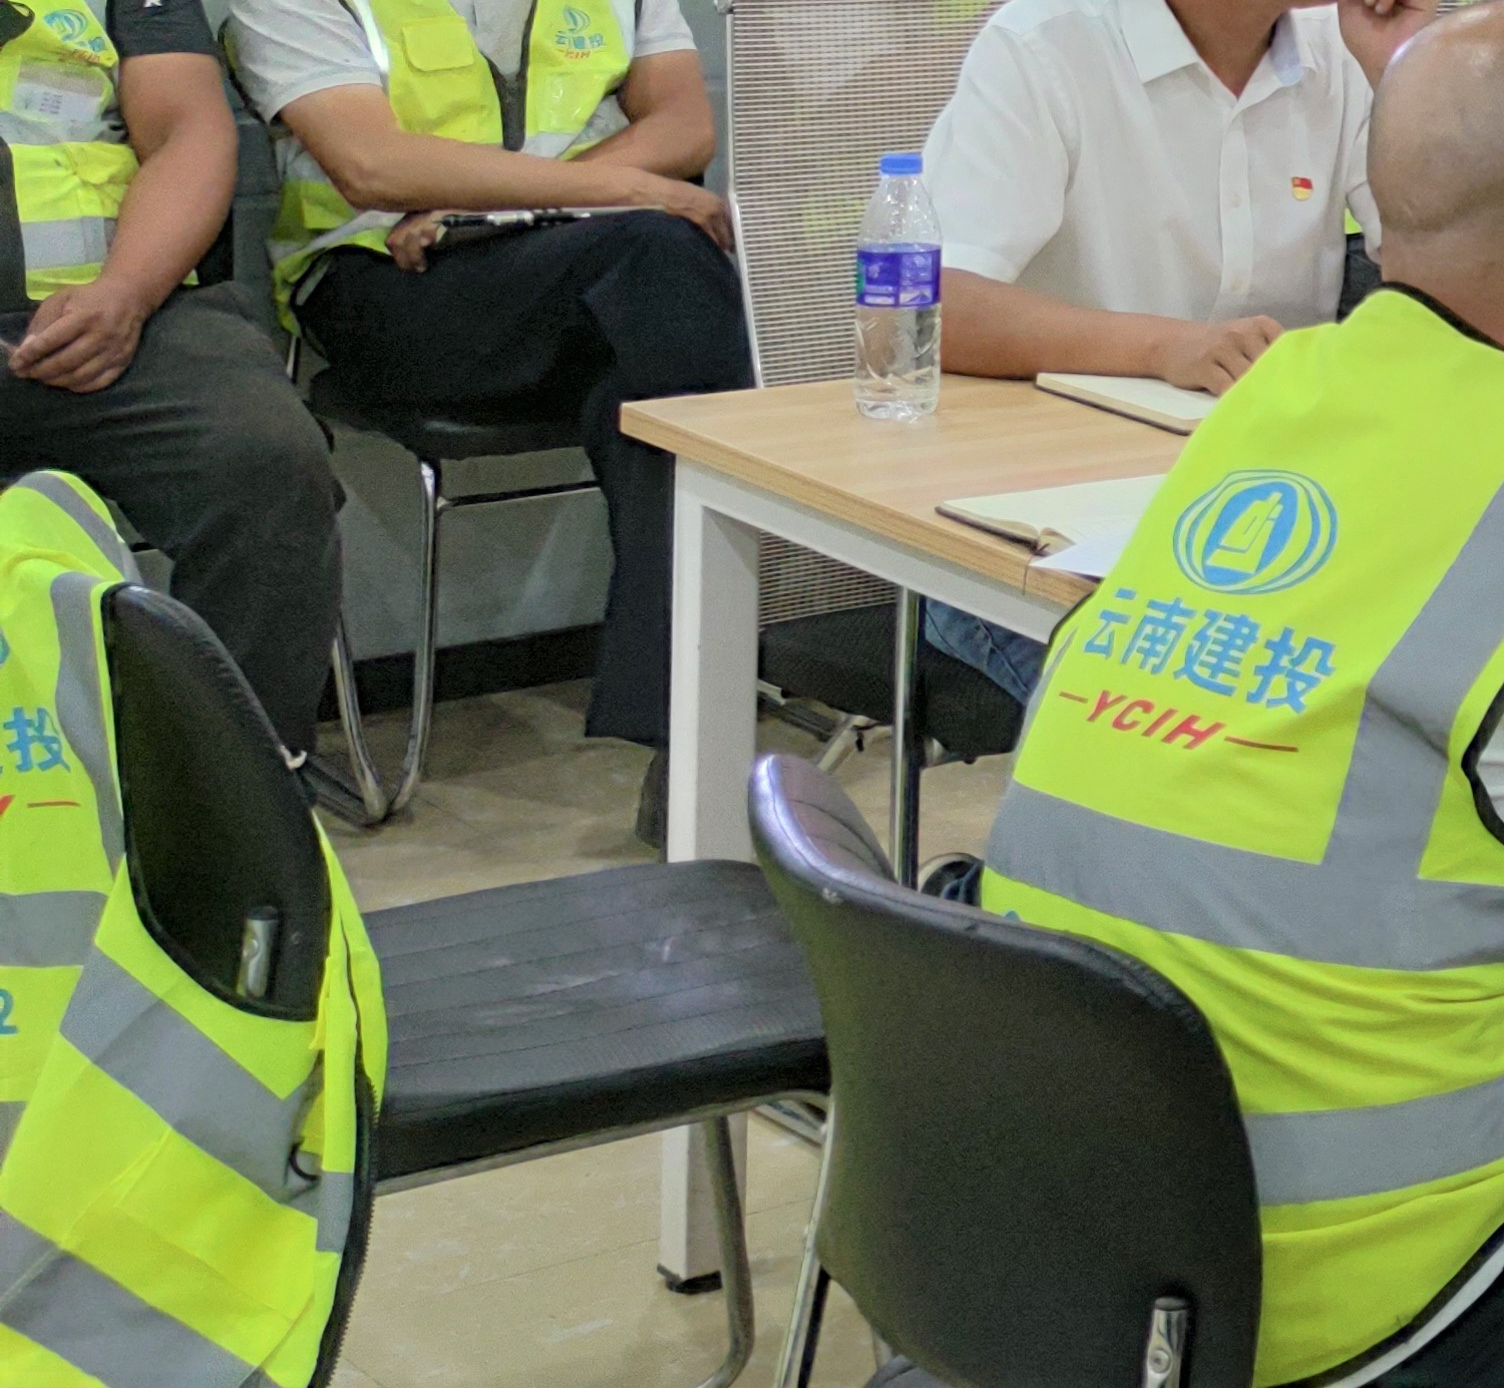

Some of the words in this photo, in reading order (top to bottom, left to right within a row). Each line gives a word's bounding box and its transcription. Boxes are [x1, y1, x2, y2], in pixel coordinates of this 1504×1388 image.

[1083, 588, 1336, 715] 云南建投
[0, 706, 71, 773] 投
[1086, 689, 1227, 750] YCIH
